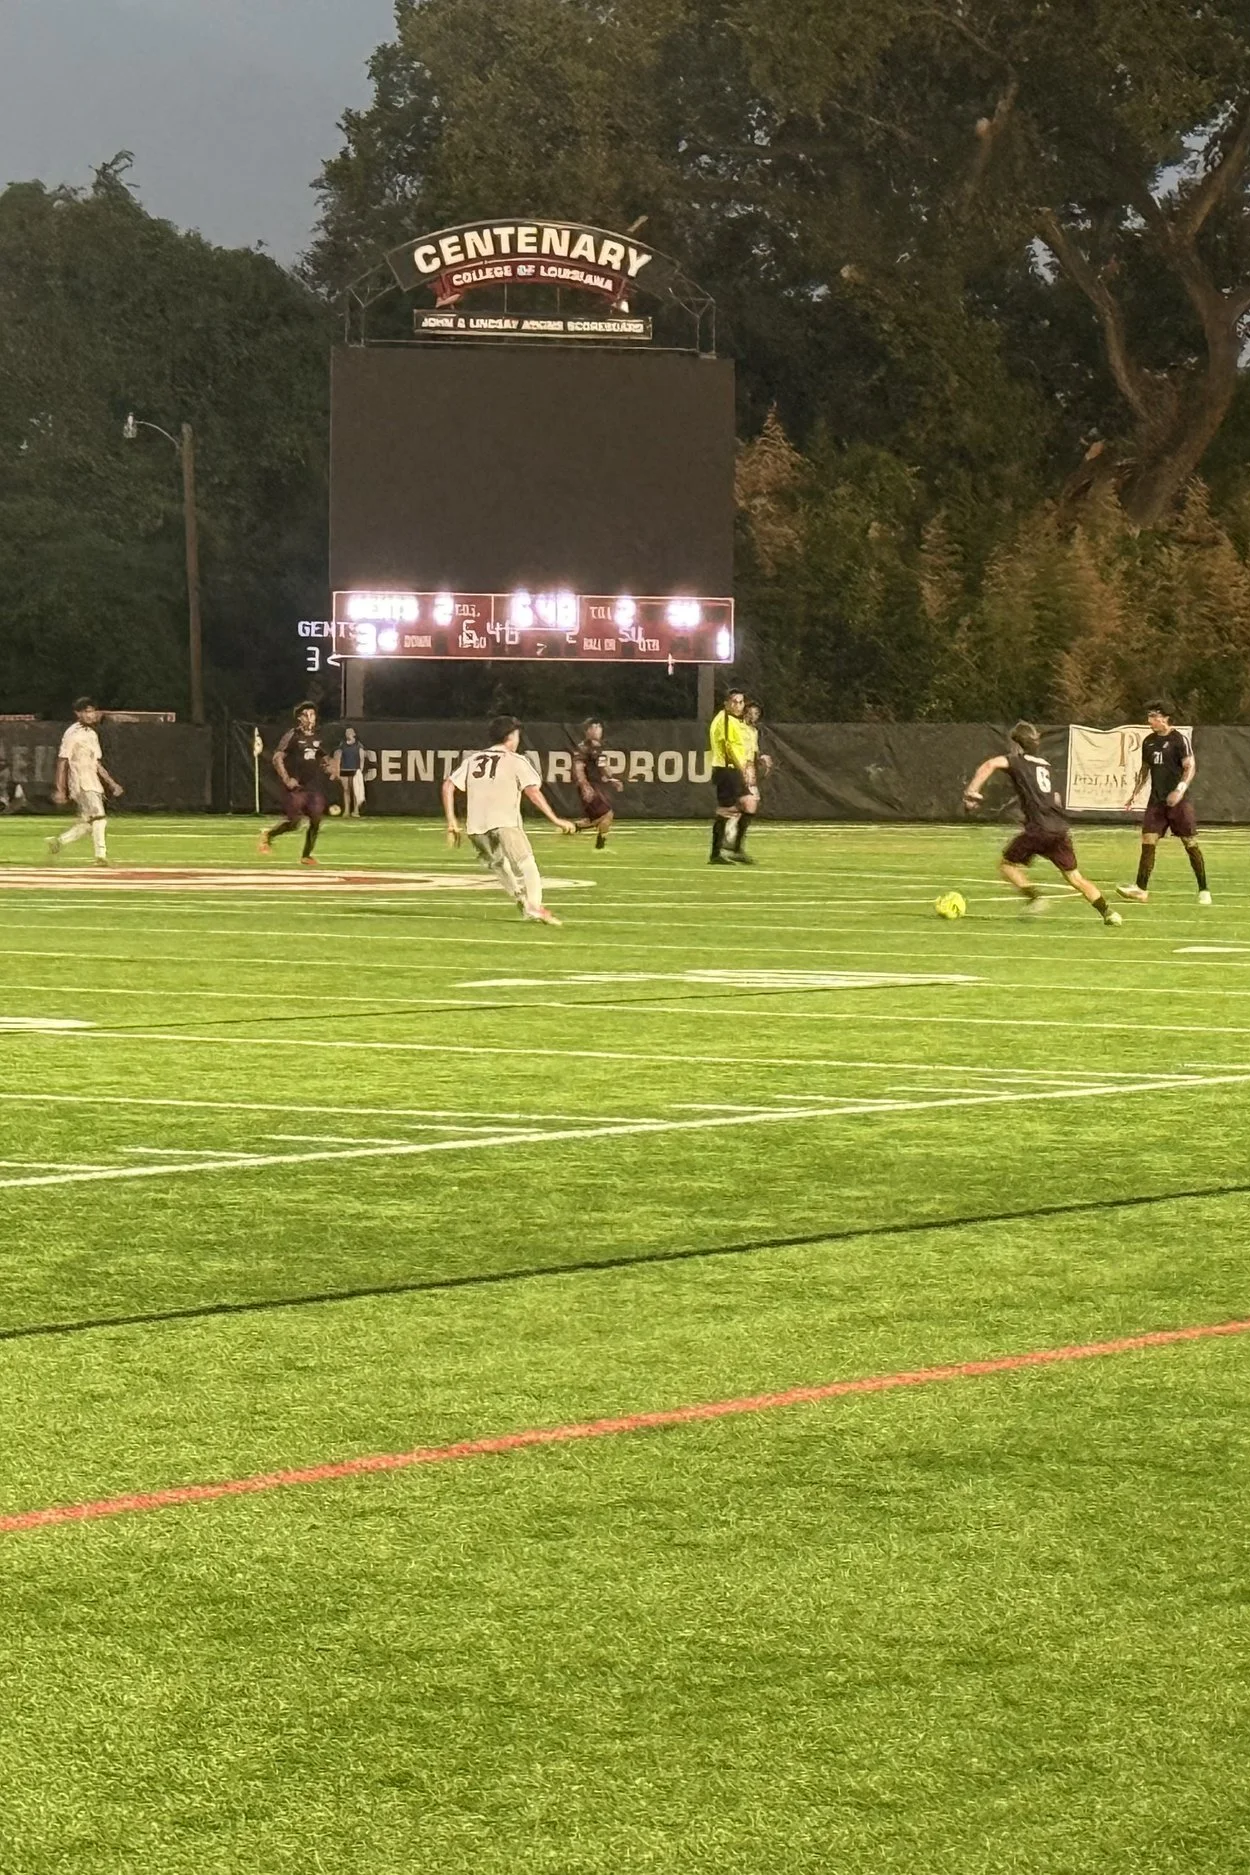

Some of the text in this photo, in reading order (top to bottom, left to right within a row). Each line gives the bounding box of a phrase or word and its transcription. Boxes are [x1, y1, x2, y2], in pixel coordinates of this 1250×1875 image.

[414, 226, 652, 278] CENTENARY
[452, 264, 613, 292] COLLEGE OF LOUISIANA
[421, 317, 454, 328] JOHN
[363, 750, 713, 783] CENTR PROU
[472, 754, 501, 779] 31
